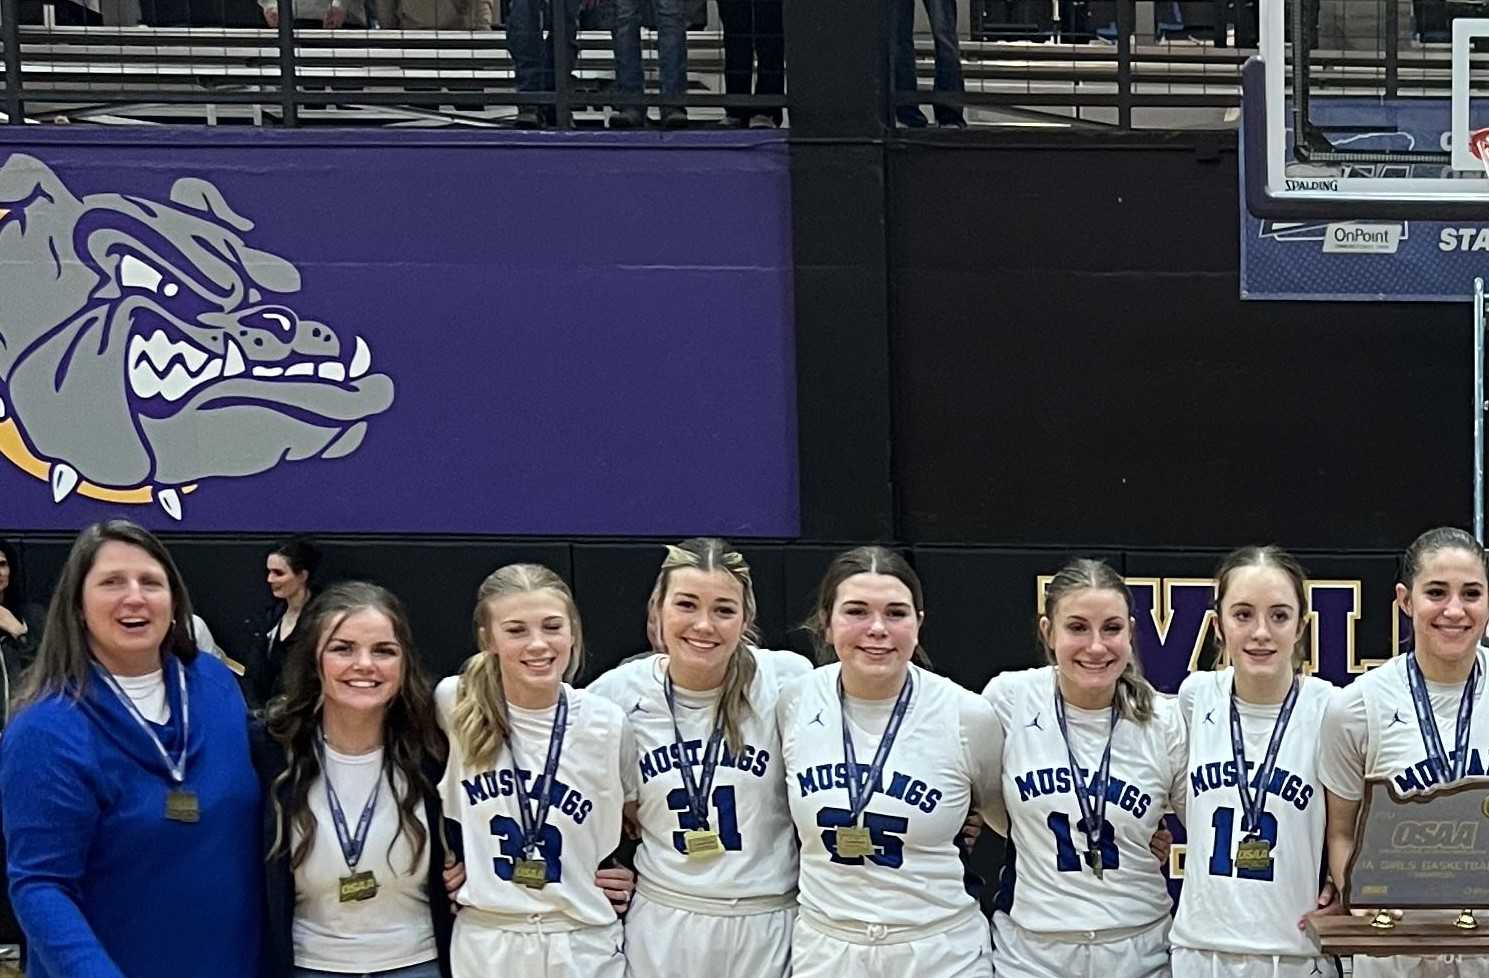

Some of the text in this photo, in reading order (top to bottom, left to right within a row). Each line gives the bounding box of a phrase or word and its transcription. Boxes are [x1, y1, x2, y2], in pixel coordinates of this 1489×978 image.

[1284, 180, 1338, 192] SPALDING
[1333, 227, 1389, 243] OnPoint
[639, 739, 770, 784] MUSTNGS
[666, 785, 742, 855] 31
[1391, 820, 1479, 849] OSAA
[1209, 806, 1278, 882] 12
[1379, 861, 1416, 870] GIRLS
